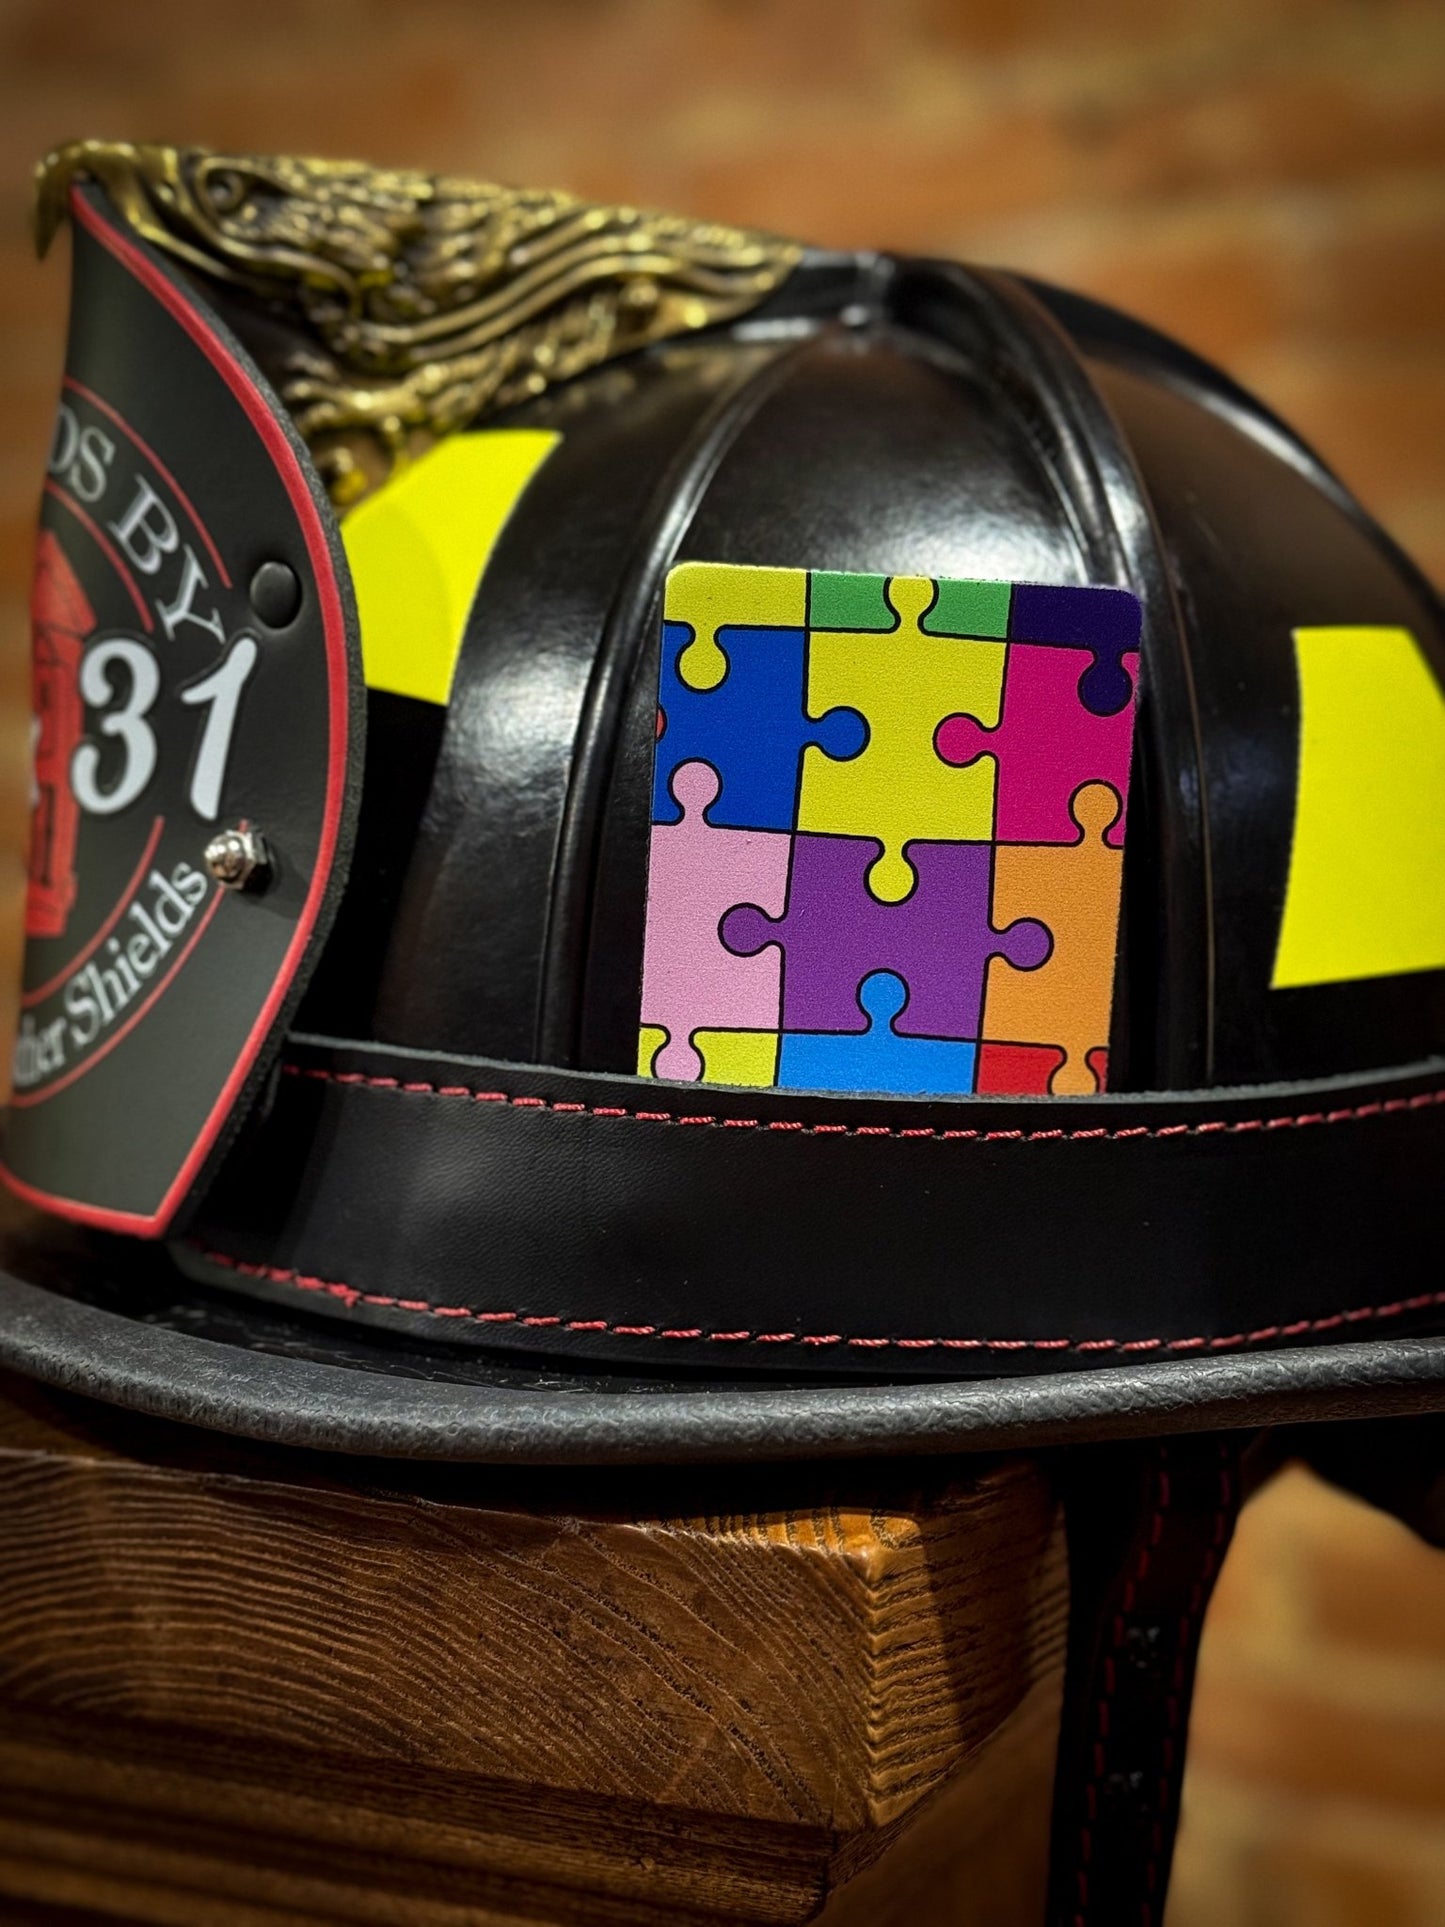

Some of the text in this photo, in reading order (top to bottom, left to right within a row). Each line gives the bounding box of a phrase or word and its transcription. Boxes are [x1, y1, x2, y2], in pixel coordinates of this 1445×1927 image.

[107, 473, 226, 644] BY
[71, 637, 257, 820] 31
[64, 861, 208, 1049] Shields
